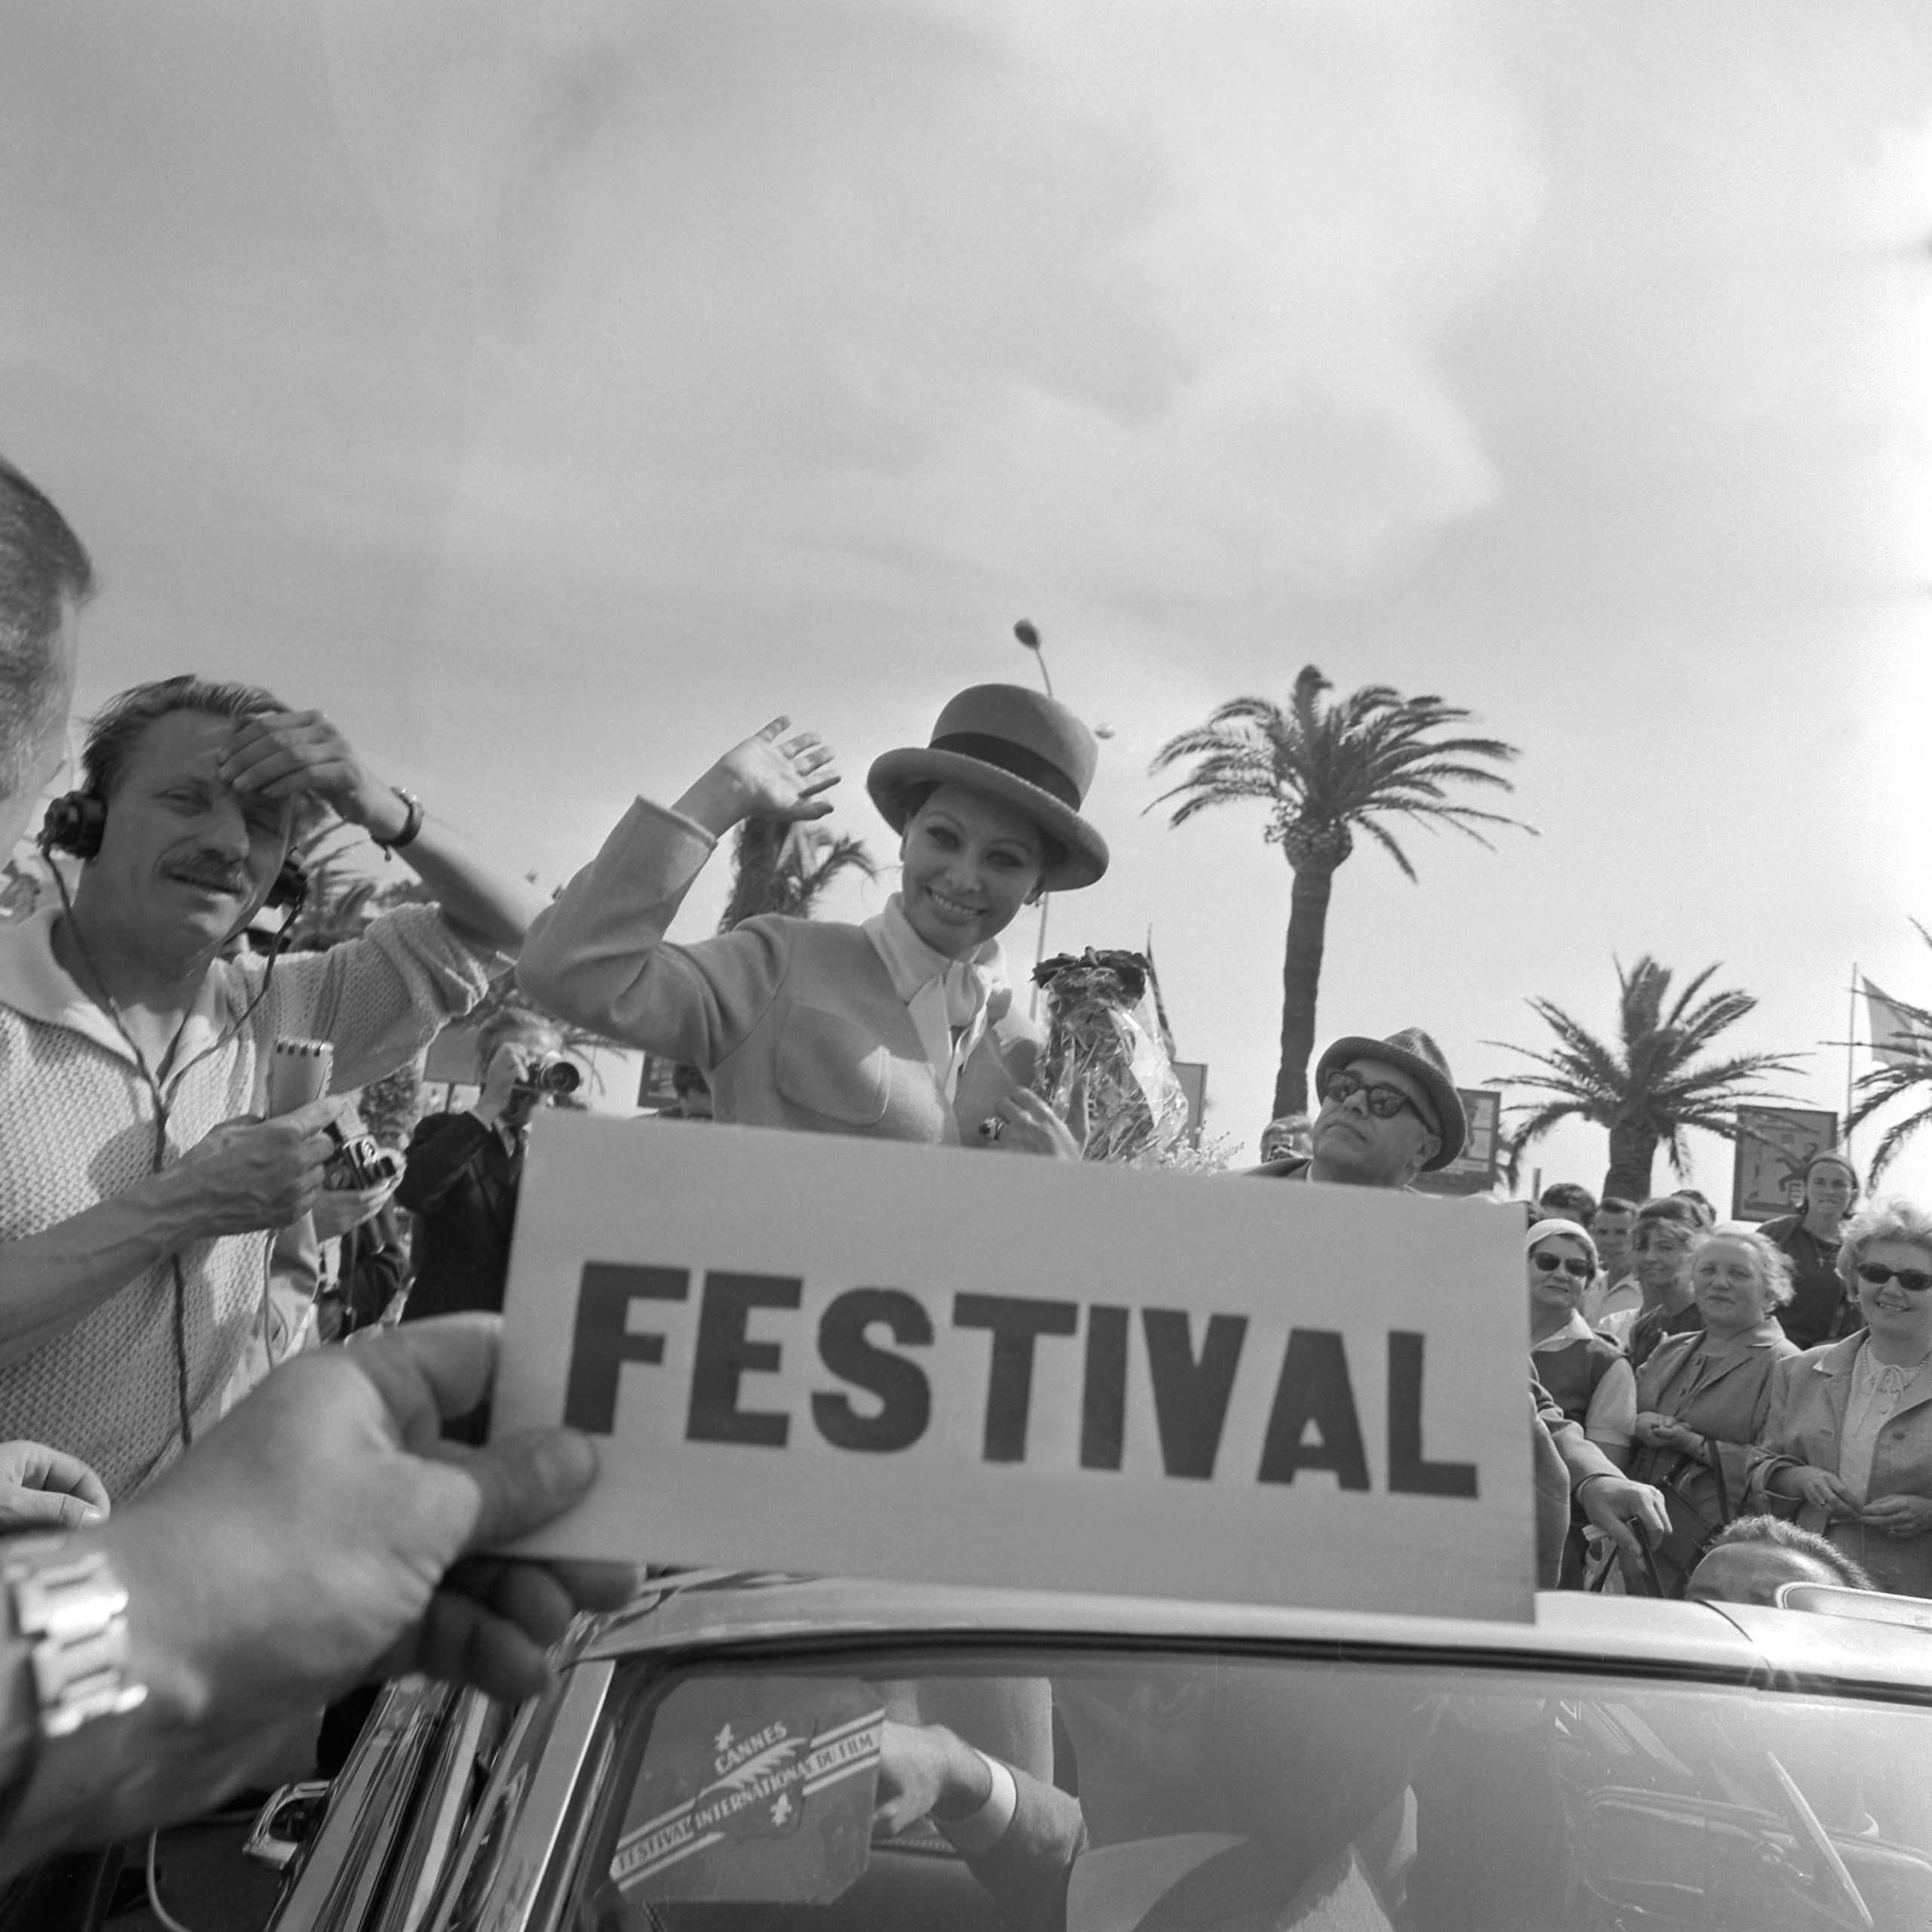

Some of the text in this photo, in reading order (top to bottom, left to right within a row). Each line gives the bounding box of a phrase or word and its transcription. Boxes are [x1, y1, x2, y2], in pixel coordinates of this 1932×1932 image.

[563, 1261, 1479, 1498] FESTIVAL
[619, 1816, 694, 1872] FESTIVAL
[817, 1750, 833, 1767] DU
[838, 1734, 872, 1758] FILM
[715, 1721, 787, 1774] CANNES
